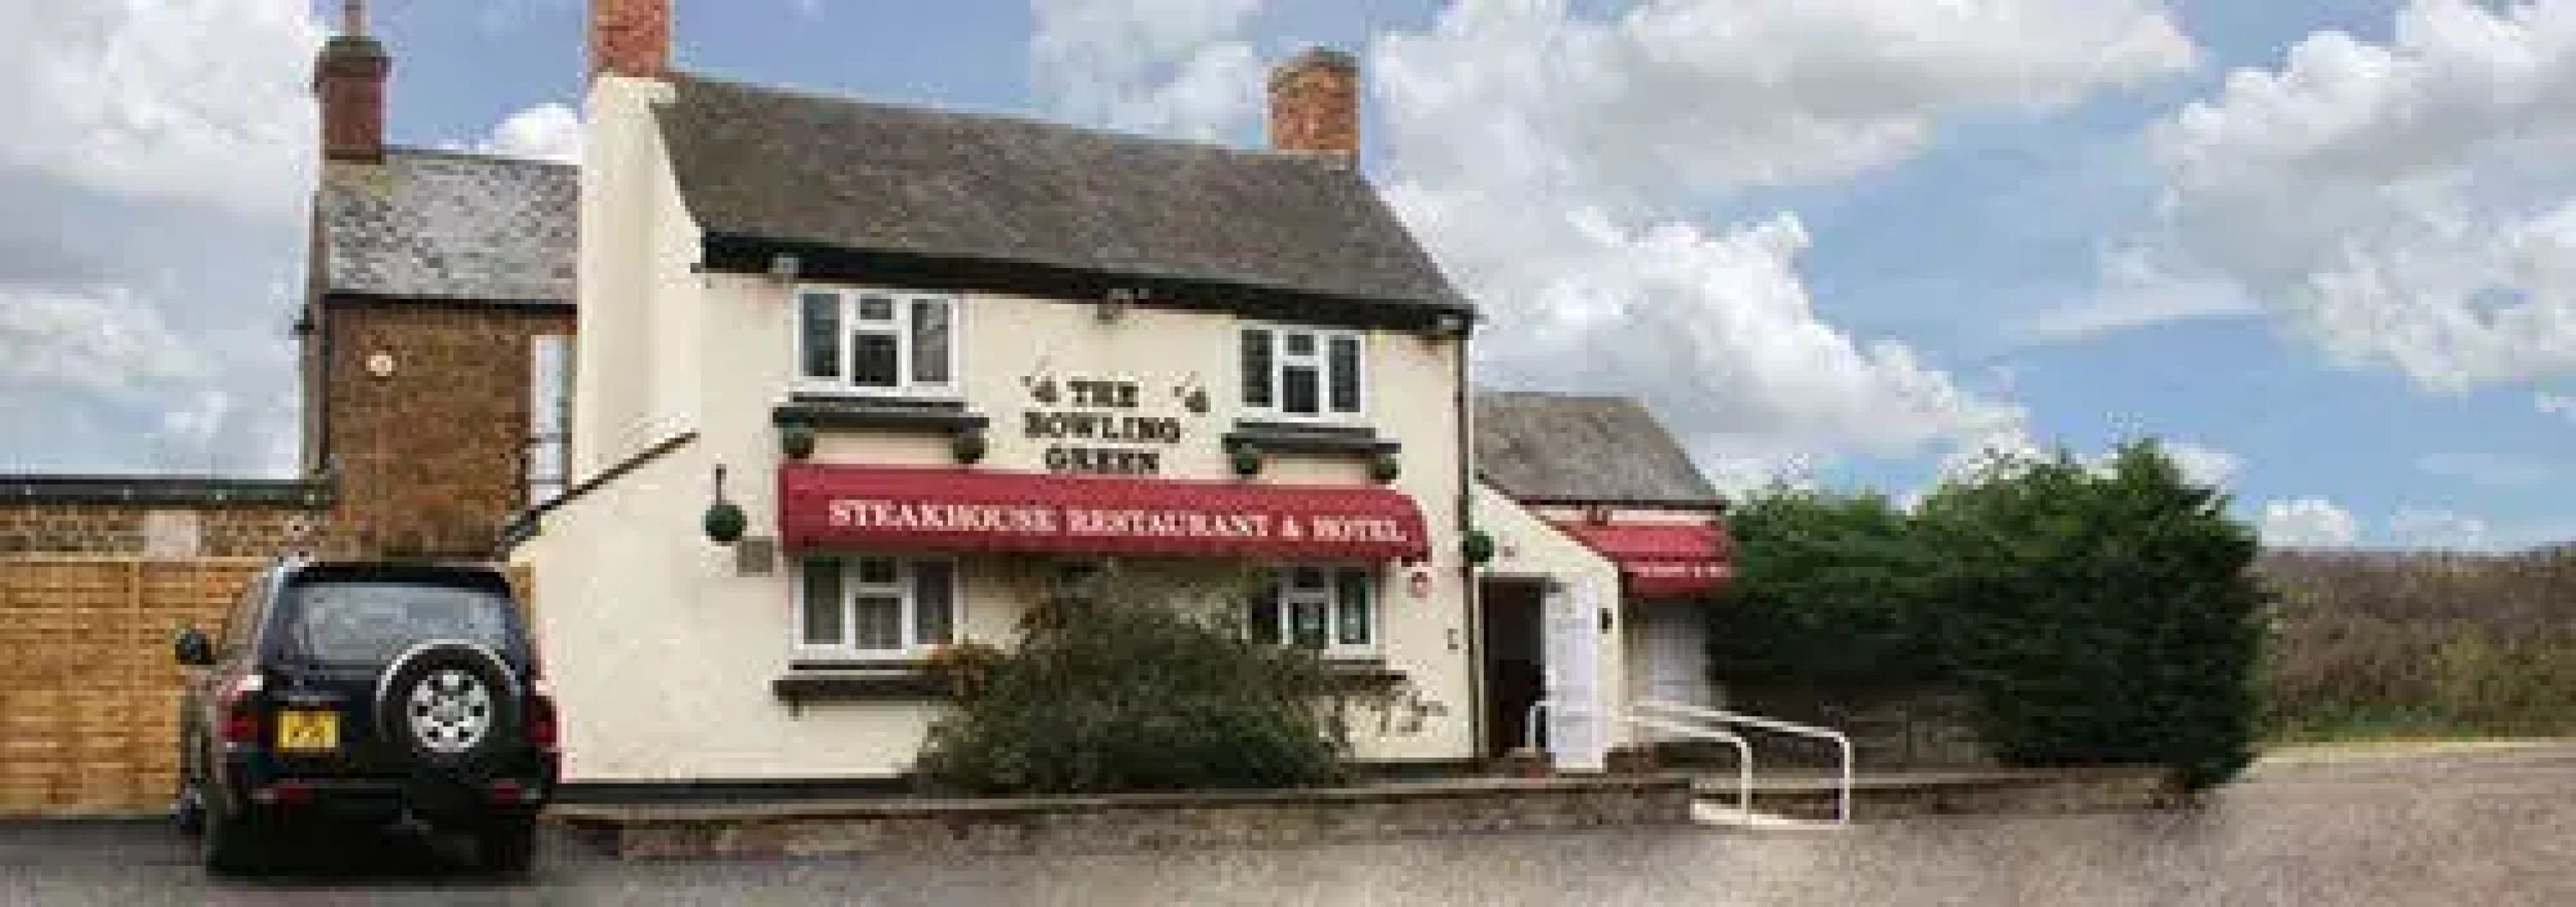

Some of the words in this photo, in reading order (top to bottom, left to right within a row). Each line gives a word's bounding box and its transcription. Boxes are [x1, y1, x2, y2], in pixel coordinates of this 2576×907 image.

[1067, 378, 1139, 408] THE
[1024, 410, 1181, 444] BOWLING
[1045, 445, 1160, 474] GREEN
[829, 500, 1057, 533] STEAKHOUSE
[1066, 508, 1270, 539] RESTAURANT
[1281, 514, 1301, 539] &
[1312, 515, 1407, 543] HOTEL
